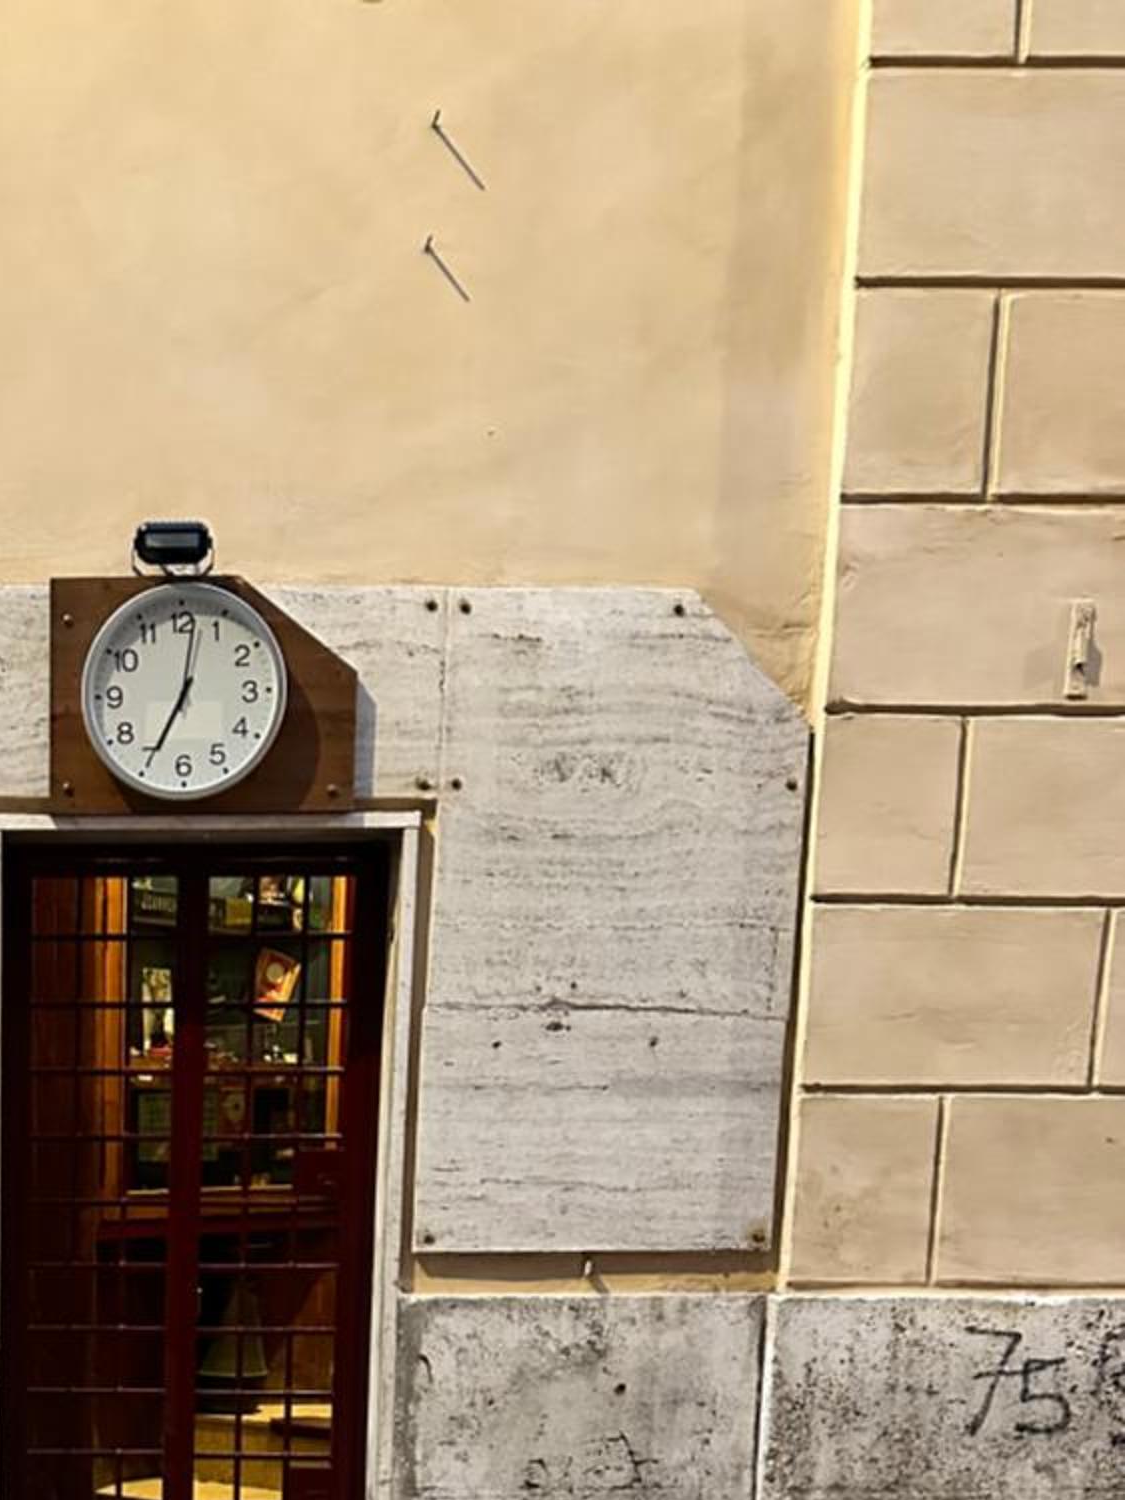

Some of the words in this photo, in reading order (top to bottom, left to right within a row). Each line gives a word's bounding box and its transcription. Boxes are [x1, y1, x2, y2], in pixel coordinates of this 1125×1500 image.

[139, 622, 156, 644] 11
[172, 612, 195, 634] 12
[213, 621, 221, 642] 1
[113, 649, 139, 672] 10
[234, 644, 251, 667] 2
[106, 685, 124, 709] 9
[241, 680, 258, 703] 3
[117, 721, 134, 744] 8
[232, 717, 249, 738] 4
[142, 746, 161, 768] 7
[175, 754, 192, 777] 6
[208, 743, 226, 766] 5
